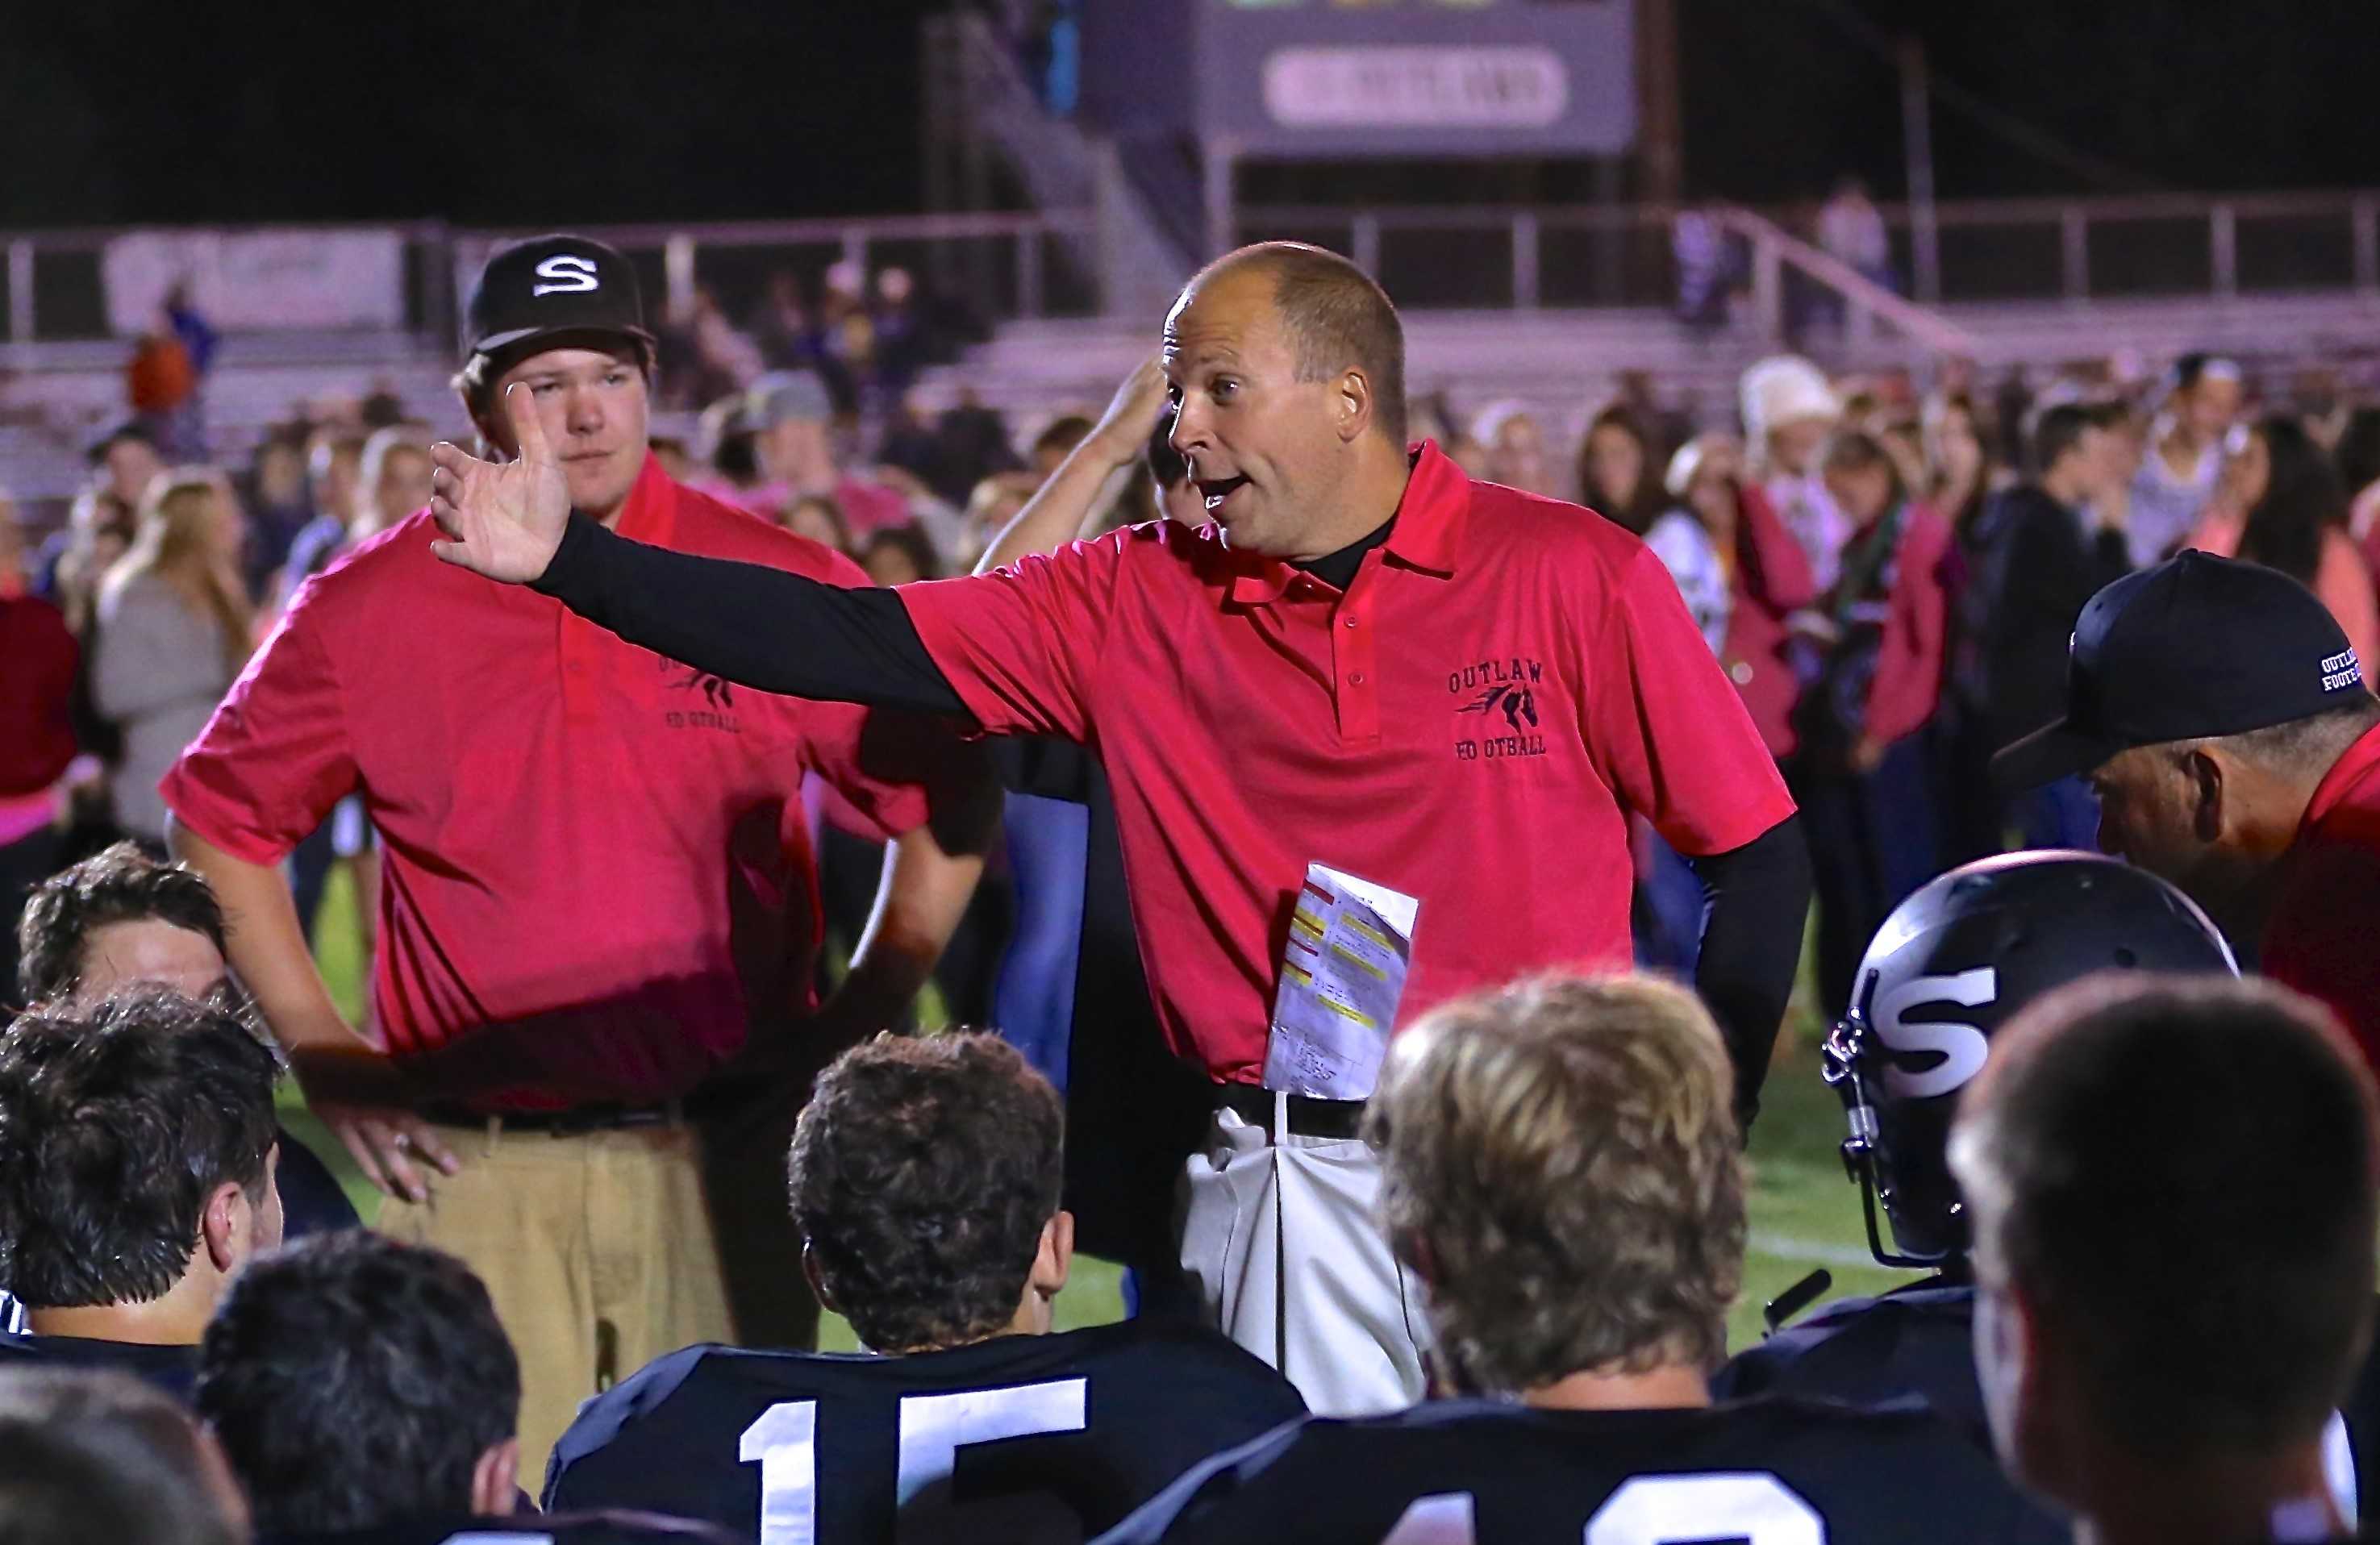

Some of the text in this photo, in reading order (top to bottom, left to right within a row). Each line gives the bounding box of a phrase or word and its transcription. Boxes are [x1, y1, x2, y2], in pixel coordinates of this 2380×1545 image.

[533, 256, 598, 297] S
[1448, 657, 1543, 693] OUTLAW
[1869, 967, 1995, 1098] S
